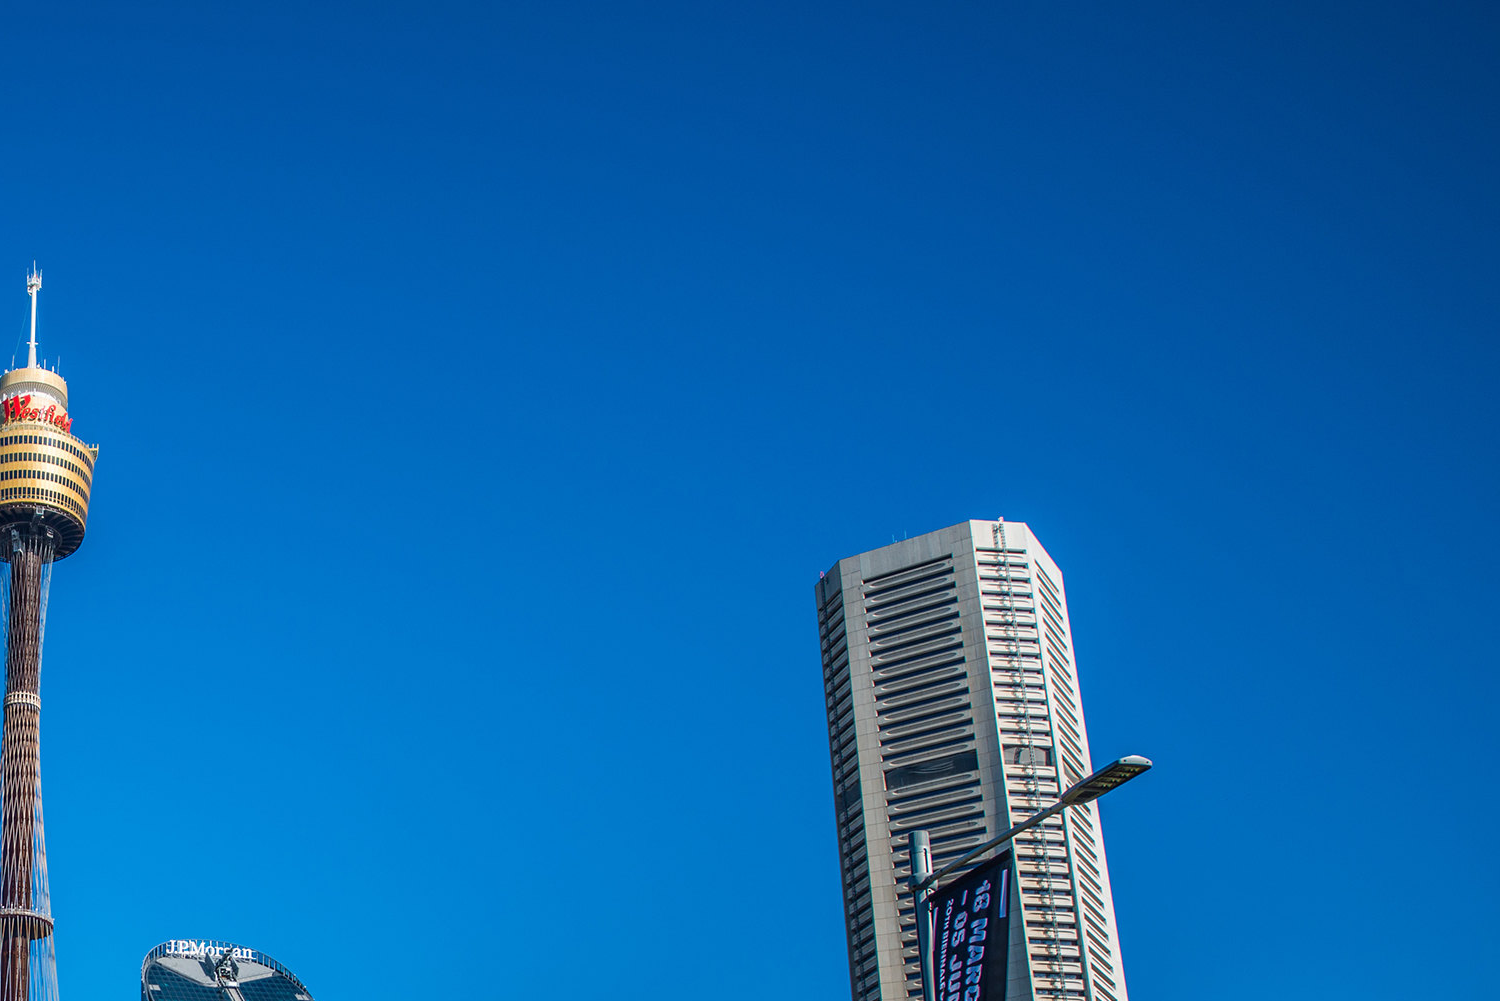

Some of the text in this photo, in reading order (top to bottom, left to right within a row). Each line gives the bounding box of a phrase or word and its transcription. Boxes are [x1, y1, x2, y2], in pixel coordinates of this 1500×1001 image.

[2, 394, 73, 433] Westfield
[973, 880, 991, 913] 18
[951, 911, 968, 947] 05
